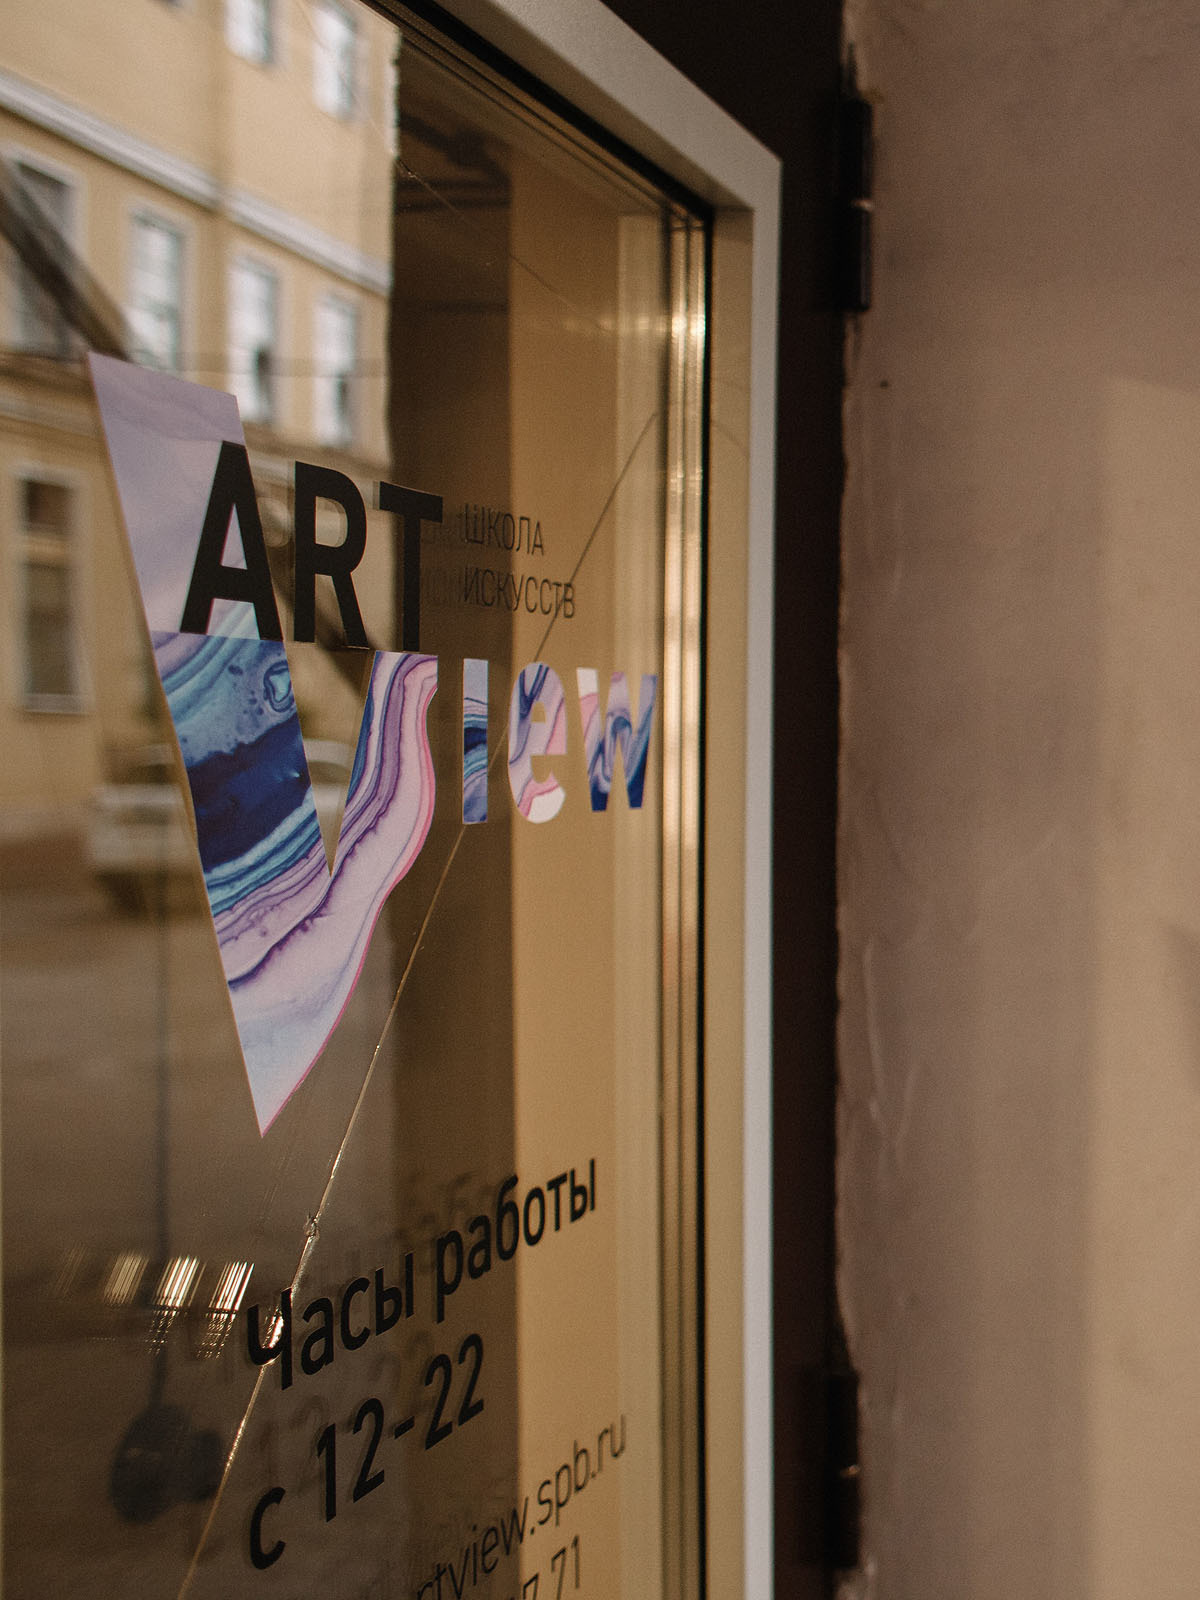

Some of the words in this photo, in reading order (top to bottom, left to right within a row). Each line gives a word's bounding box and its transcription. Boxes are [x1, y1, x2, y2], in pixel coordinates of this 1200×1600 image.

[179, 440, 443, 652] ART
[463, 566, 575, 619] ИСКУССТВ
[464, 503, 544, 556] ШКОЛА
[246, 1252, 414, 1390] Часы
[436, 1158, 596, 1323] работы
[317, 1333, 484, 1522] 12-22
